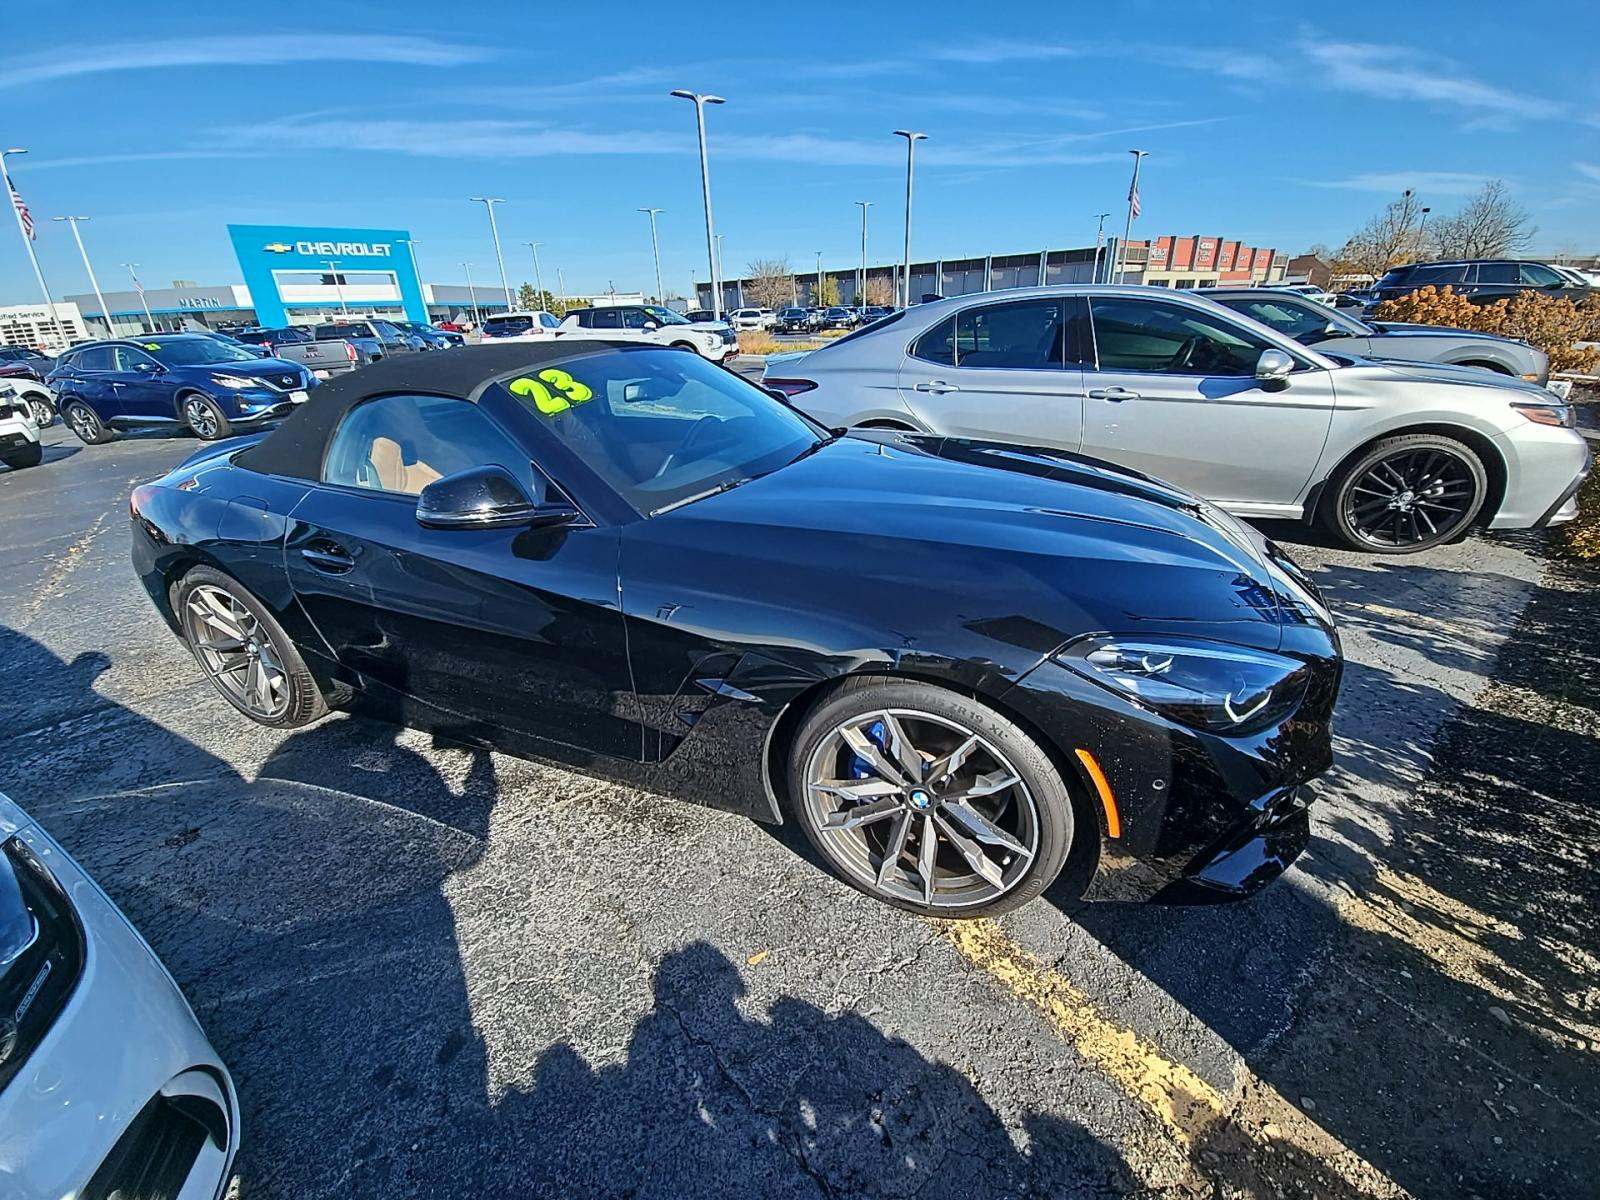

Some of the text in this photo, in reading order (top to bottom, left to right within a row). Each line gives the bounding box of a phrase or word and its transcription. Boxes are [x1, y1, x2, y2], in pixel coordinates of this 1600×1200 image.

[296, 241, 392, 257] CHEVROLET
[178, 297, 221, 309] MARTIN
[509, 368, 593, 415] 23
